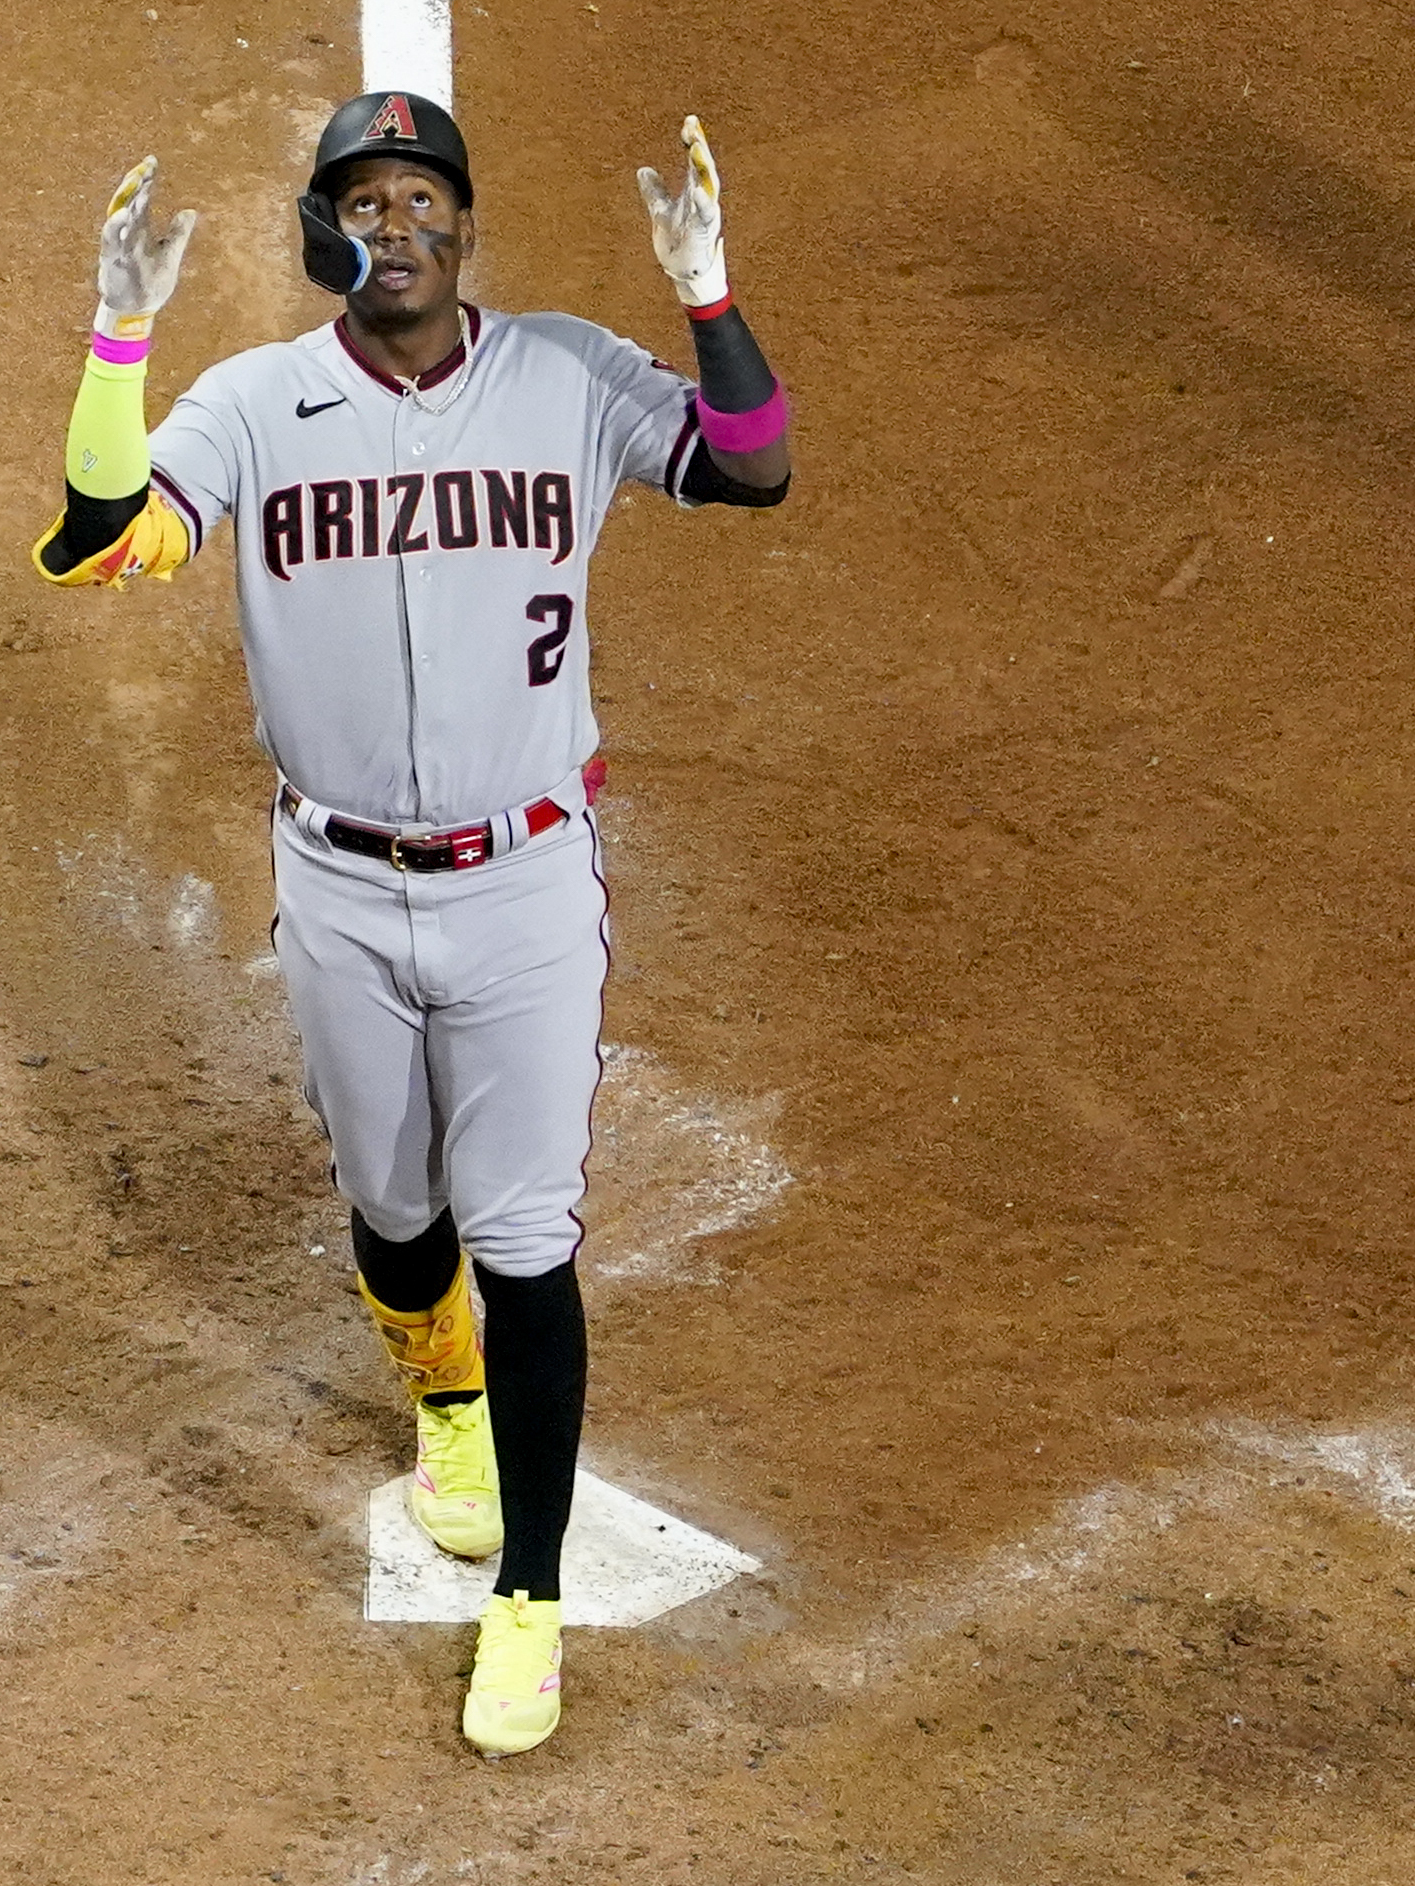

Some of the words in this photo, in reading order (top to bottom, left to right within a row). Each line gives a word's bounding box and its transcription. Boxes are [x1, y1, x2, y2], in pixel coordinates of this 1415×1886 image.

[361, 94, 418, 141] A
[261, 469, 576, 583] ARIZONA
[525, 593, 574, 688] 2
